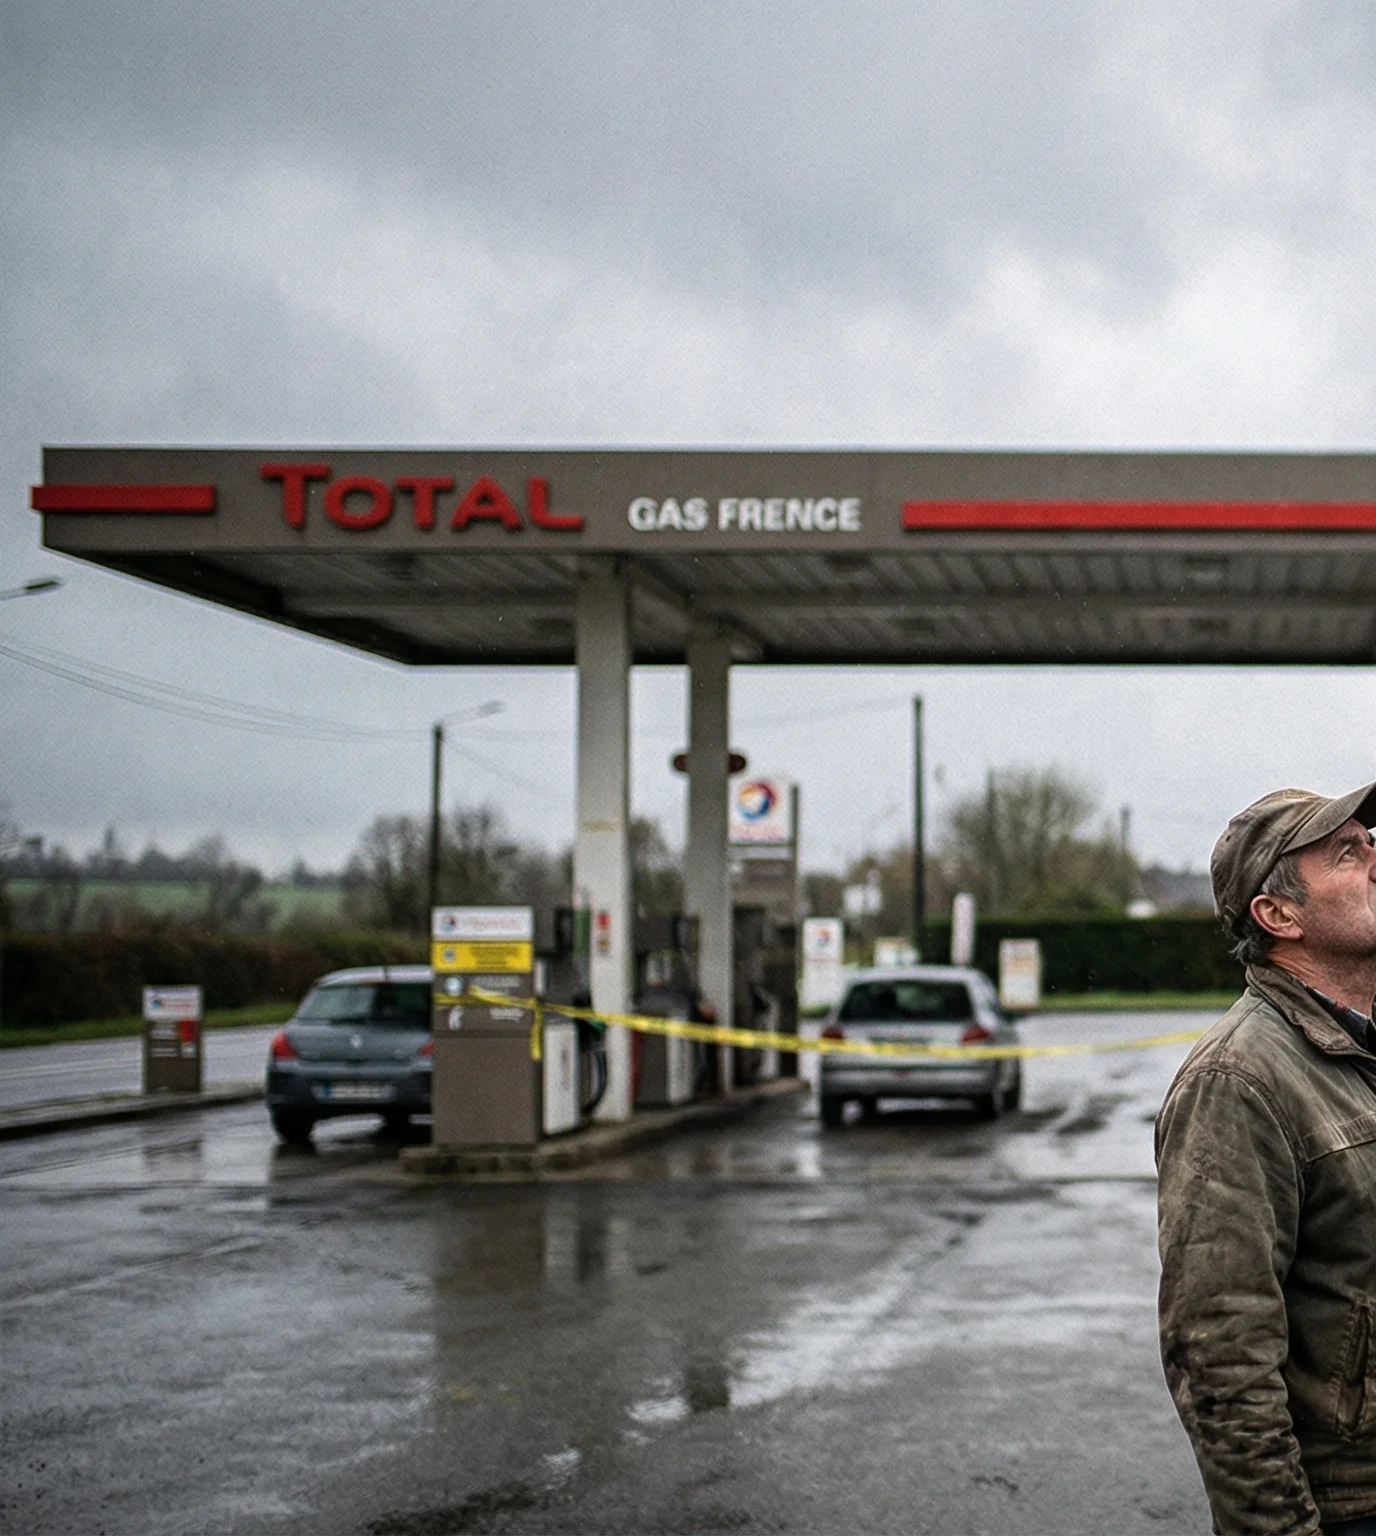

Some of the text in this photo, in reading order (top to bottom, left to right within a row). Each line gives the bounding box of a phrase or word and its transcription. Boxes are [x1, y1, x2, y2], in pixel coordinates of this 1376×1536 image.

[260, 462, 584, 532] TOTAL
[627, 497, 862, 532] GAS FRENCE
